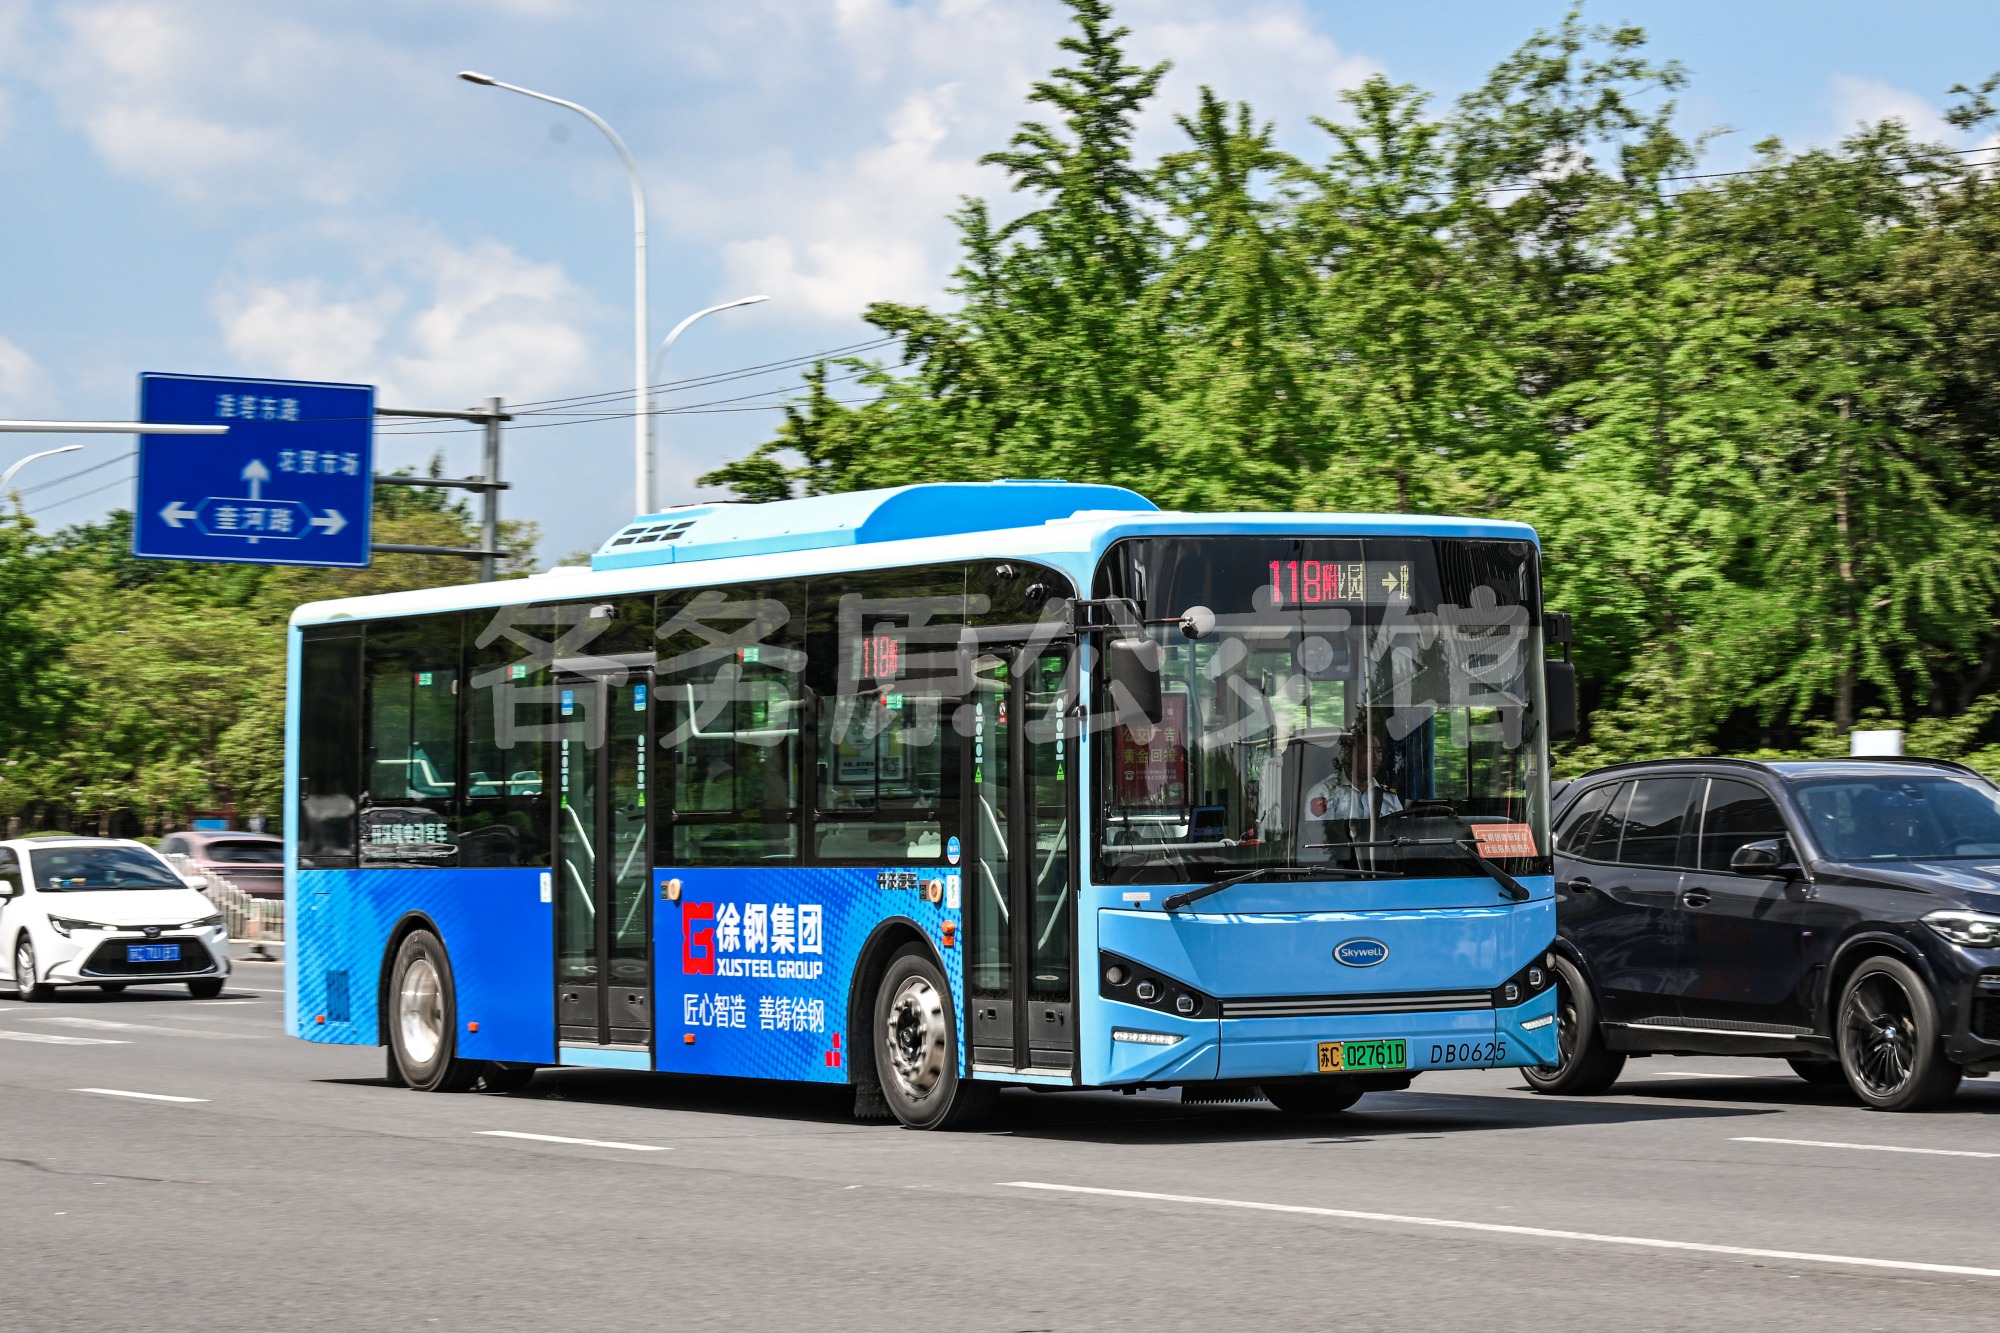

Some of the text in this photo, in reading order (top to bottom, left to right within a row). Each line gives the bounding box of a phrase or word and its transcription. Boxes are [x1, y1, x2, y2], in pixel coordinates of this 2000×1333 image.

[716, 902, 823, 955] 徐钢集团
[1341, 948, 1383, 957] Skywell
[716, 958, 823, 980] XUSTEEL GROUP
[683, 993, 825, 1033] 匠心智造 善铸徐钢
[1430, 1041, 1507, 1064] DB0625
